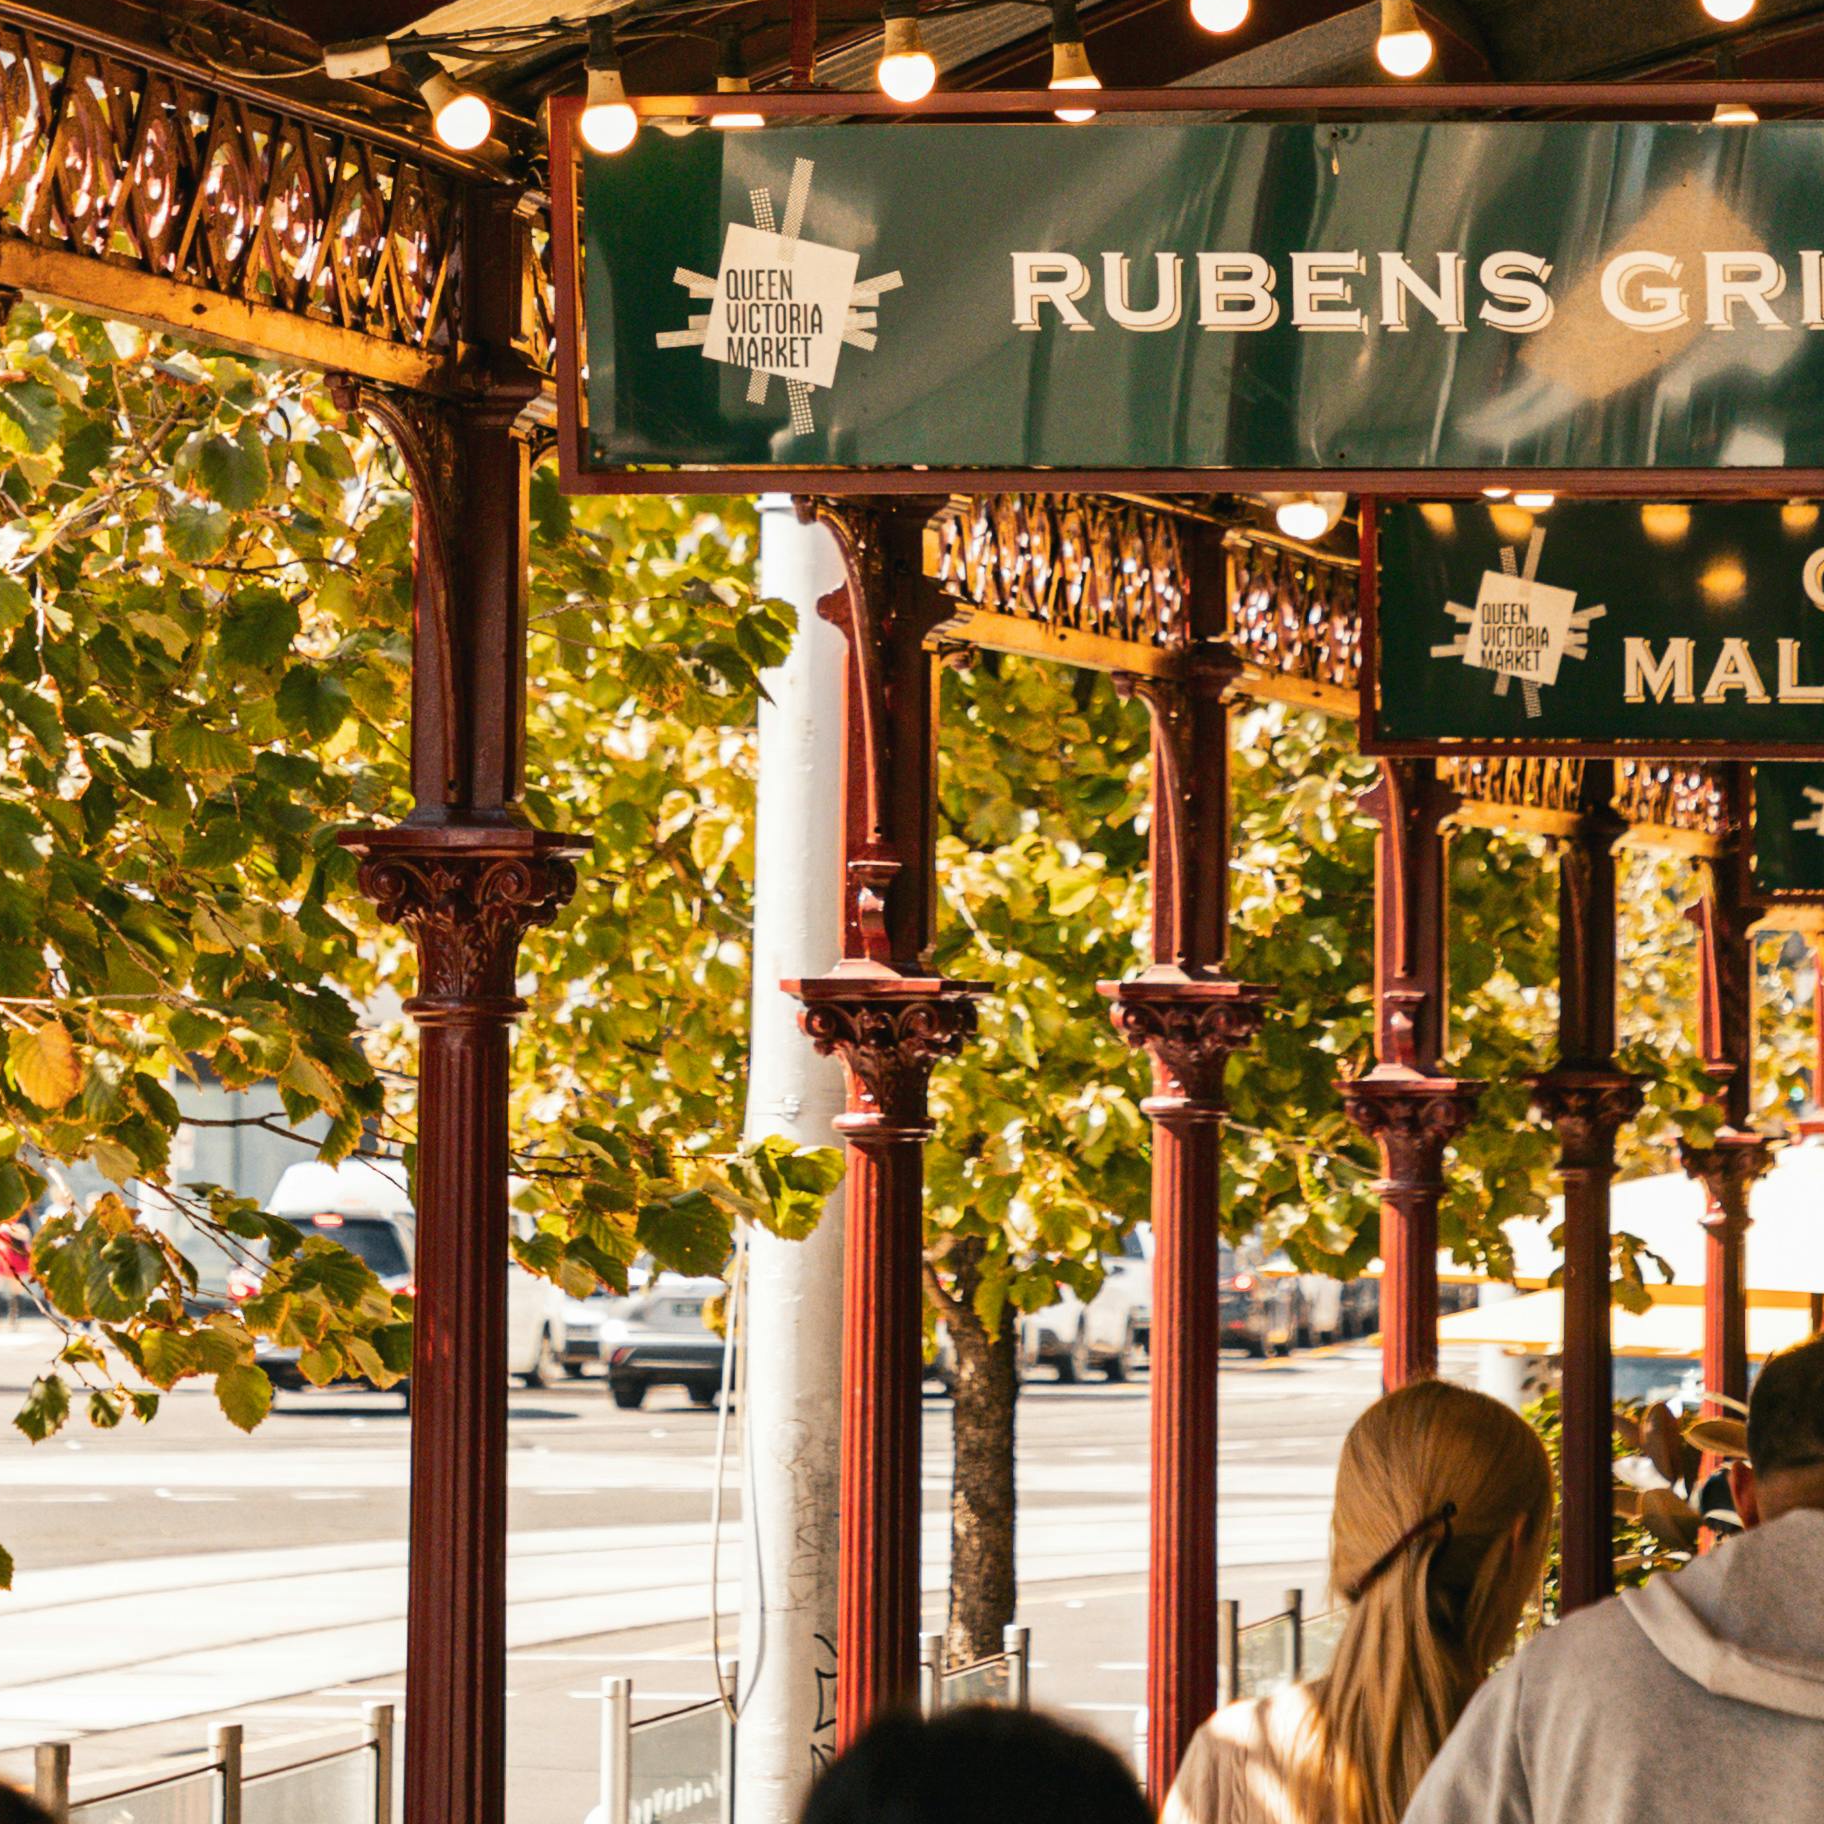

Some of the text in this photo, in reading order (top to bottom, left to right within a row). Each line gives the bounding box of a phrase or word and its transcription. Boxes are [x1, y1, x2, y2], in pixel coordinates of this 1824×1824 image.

[725, 268, 793, 301] QUEEN
[1010, 249, 1555, 334] RUBENS
[726, 303, 823, 335] VICTORIA
[726, 336, 812, 368] MARKET
[1481, 602, 1530, 625] QUEEN
[1481, 625, 1550, 648] VICTORIA
[1481, 649, 1541, 672] MARKET
